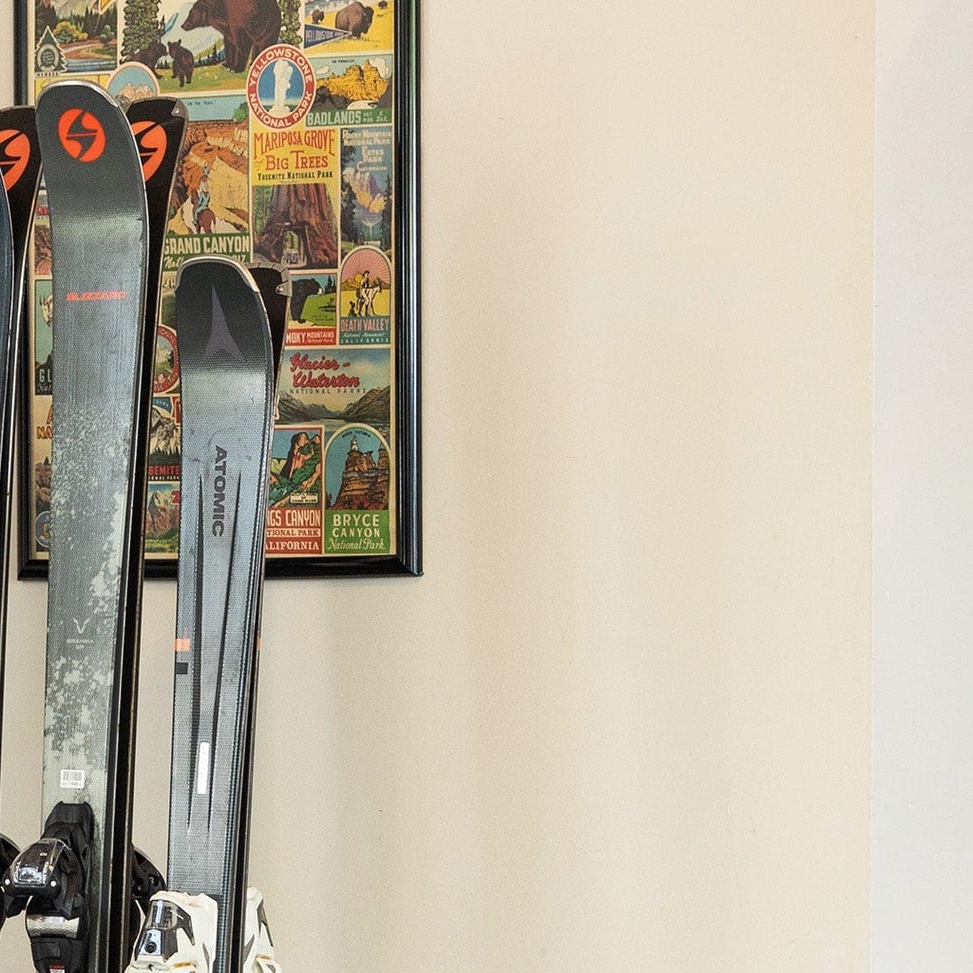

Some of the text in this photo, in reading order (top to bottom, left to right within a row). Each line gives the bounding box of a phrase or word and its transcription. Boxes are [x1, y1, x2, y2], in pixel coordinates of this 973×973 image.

[249, 48, 313, 86] YELLOWSTONE
[249, 91, 313, 128] NATIONAL PARK
[307, 110, 361, 125] BADLANDS
[253, 129, 335, 160] MARIPOSA GROVE
[265, 155, 289, 171] BIG
[289, 150, 328, 169] TREES
[258, 170, 333, 181] YOSEMITE NATIONAL PARK
[164, 236, 250, 254] GRAND CANYON
[66, 290, 126, 301] BLIZZARD
[340, 318, 389, 331] DEATH VALLEY
[285, 331, 334, 344] MOKY MOUNTAINS
[289, 352, 340, 372] Glacier
[292, 371, 361, 388] Waterton
[148, 465, 180, 476] SEMITE
[211, 444, 228, 537] ATOMIC
[285, 509, 321, 527] CANYON
[332, 513, 381, 527] BRYCE
[331, 528, 381, 538] CANYON
[266, 541, 320, 551] LIFORNIA
[327, 538, 387, 551] National Park
